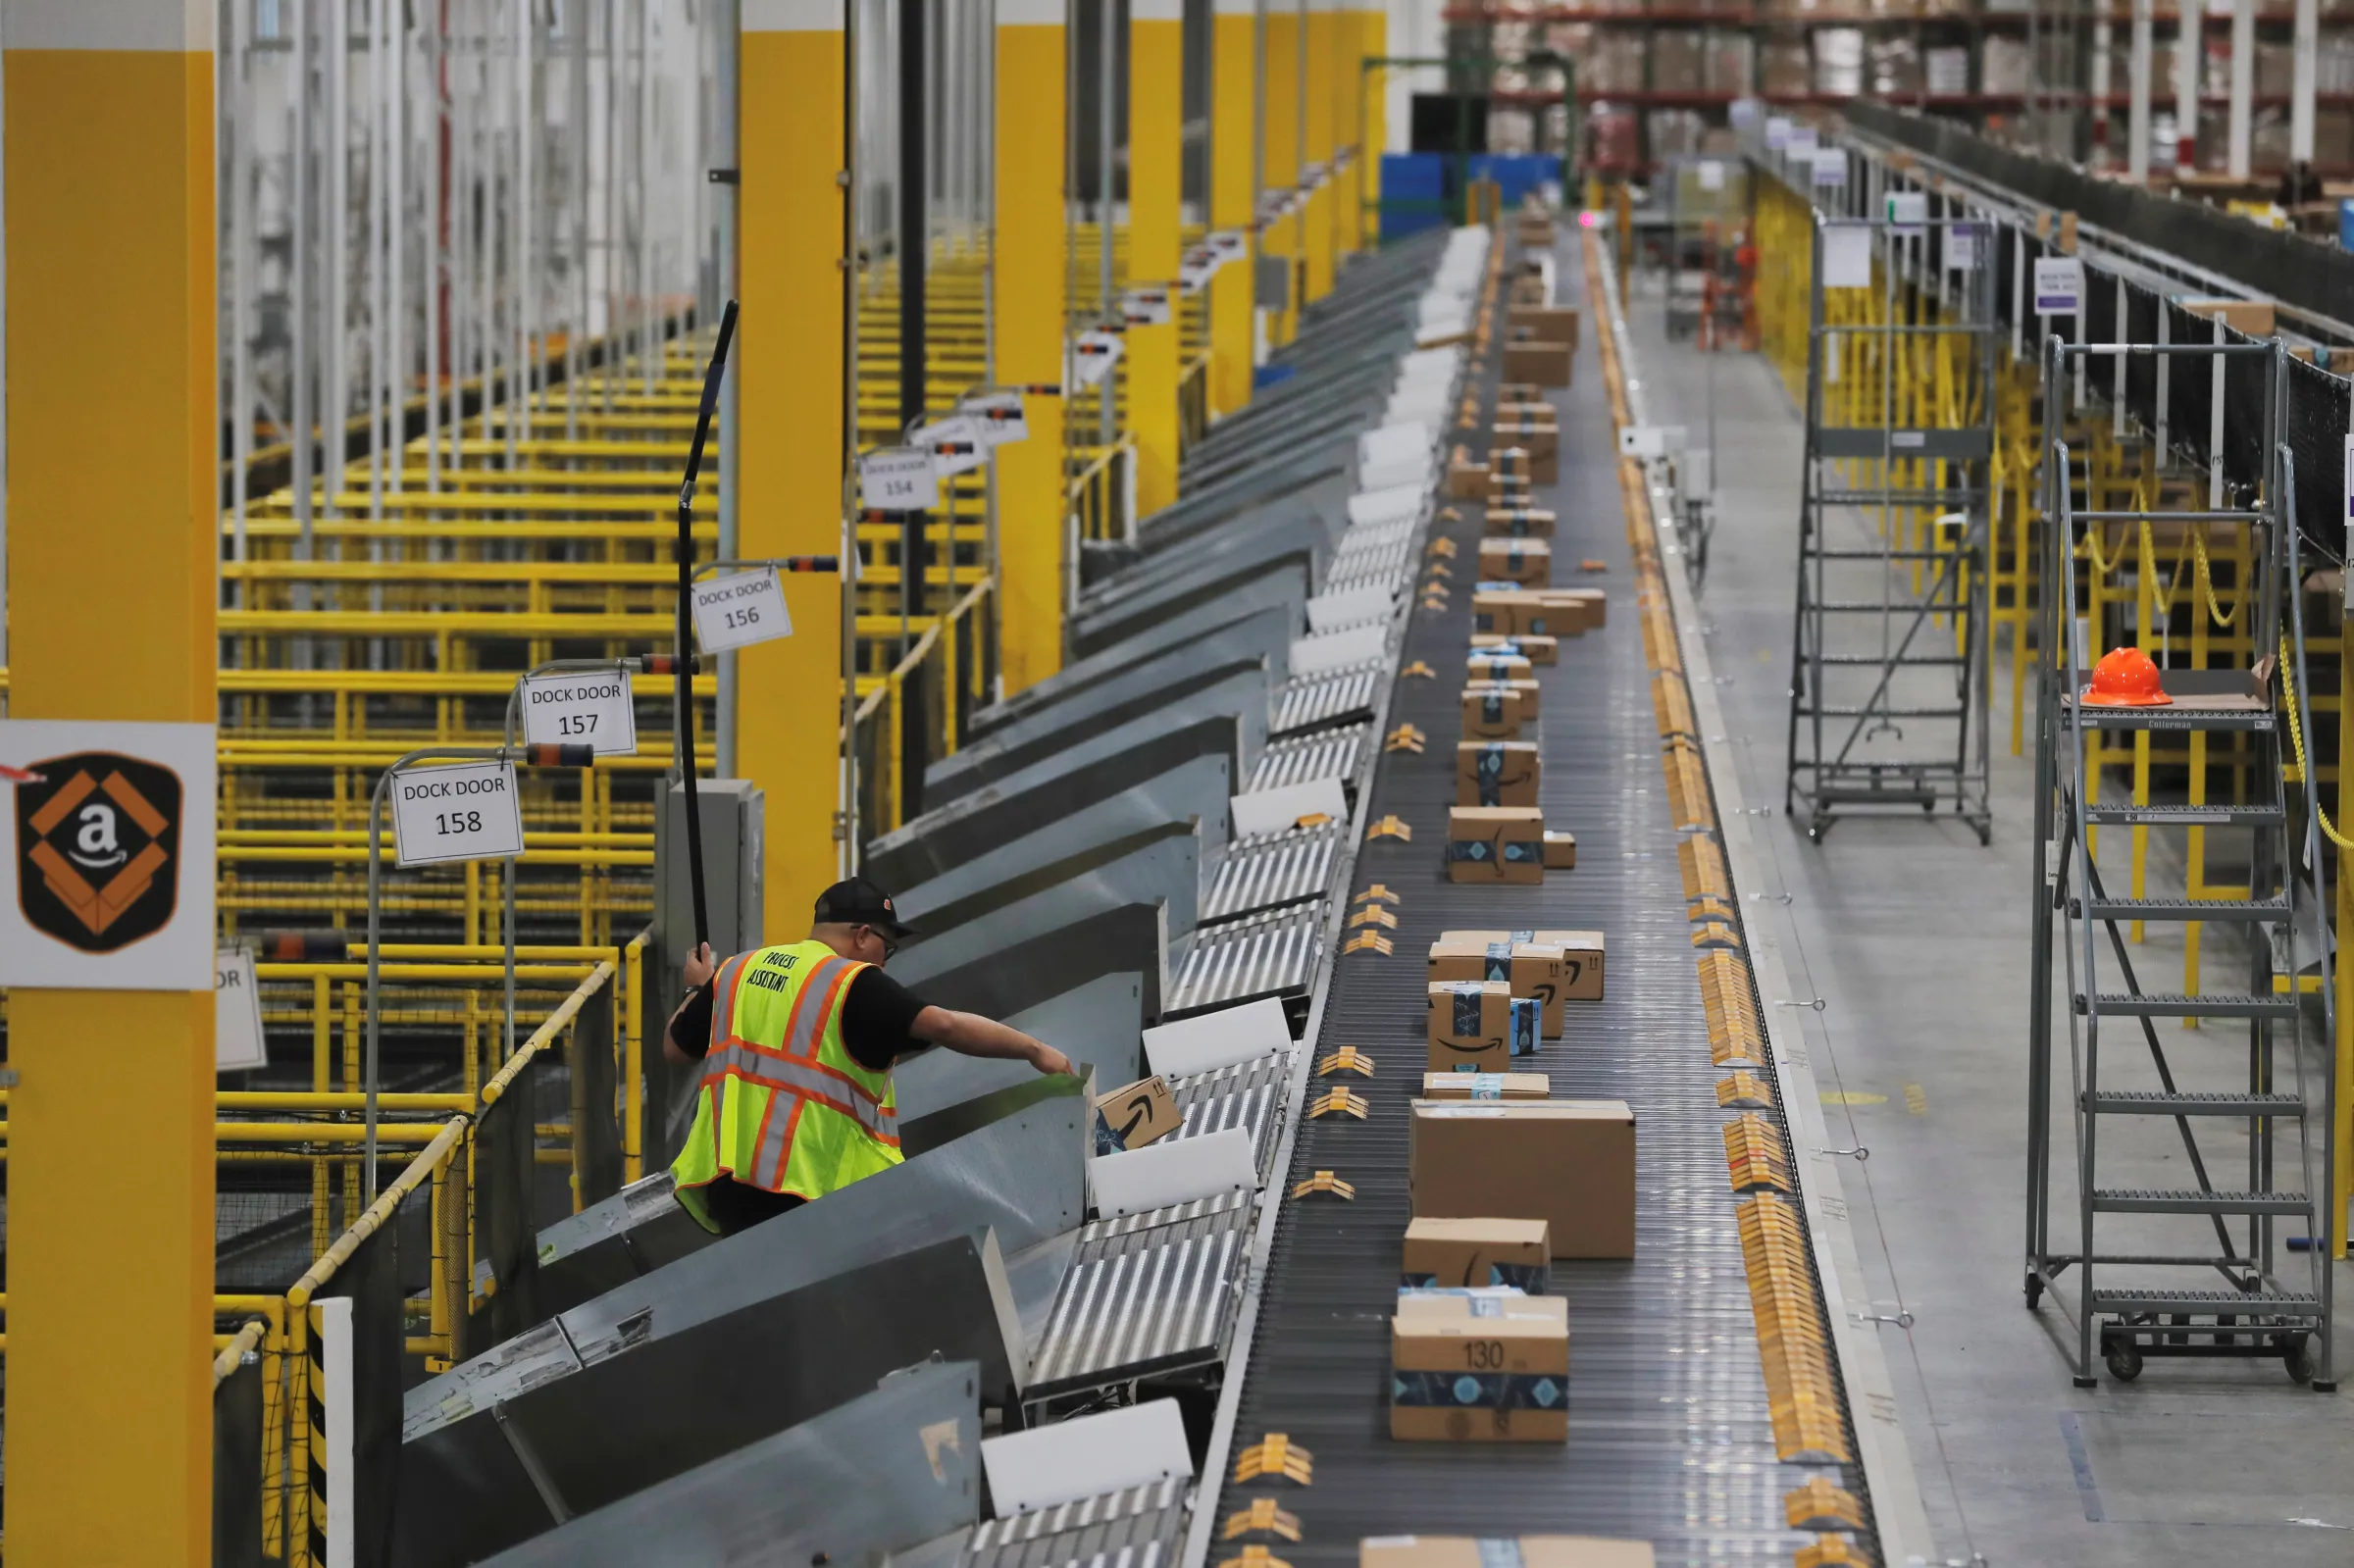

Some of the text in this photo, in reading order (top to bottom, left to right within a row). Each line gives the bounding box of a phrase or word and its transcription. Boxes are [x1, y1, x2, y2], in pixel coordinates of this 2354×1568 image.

[884, 481, 913, 496] 154
[698, 580, 773, 606] DOCK DOOR
[725, 606, 760, 630] 156
[532, 684, 621, 704] DOCK DOOR
[559, 714, 598, 735] 157
[404, 778, 505, 800] DOCK DOOR
[77, 803, 119, 853] a
[436, 811, 483, 835] 158
[215, 969, 240, 989] OR
[1463, 1340, 1505, 1369] 130
